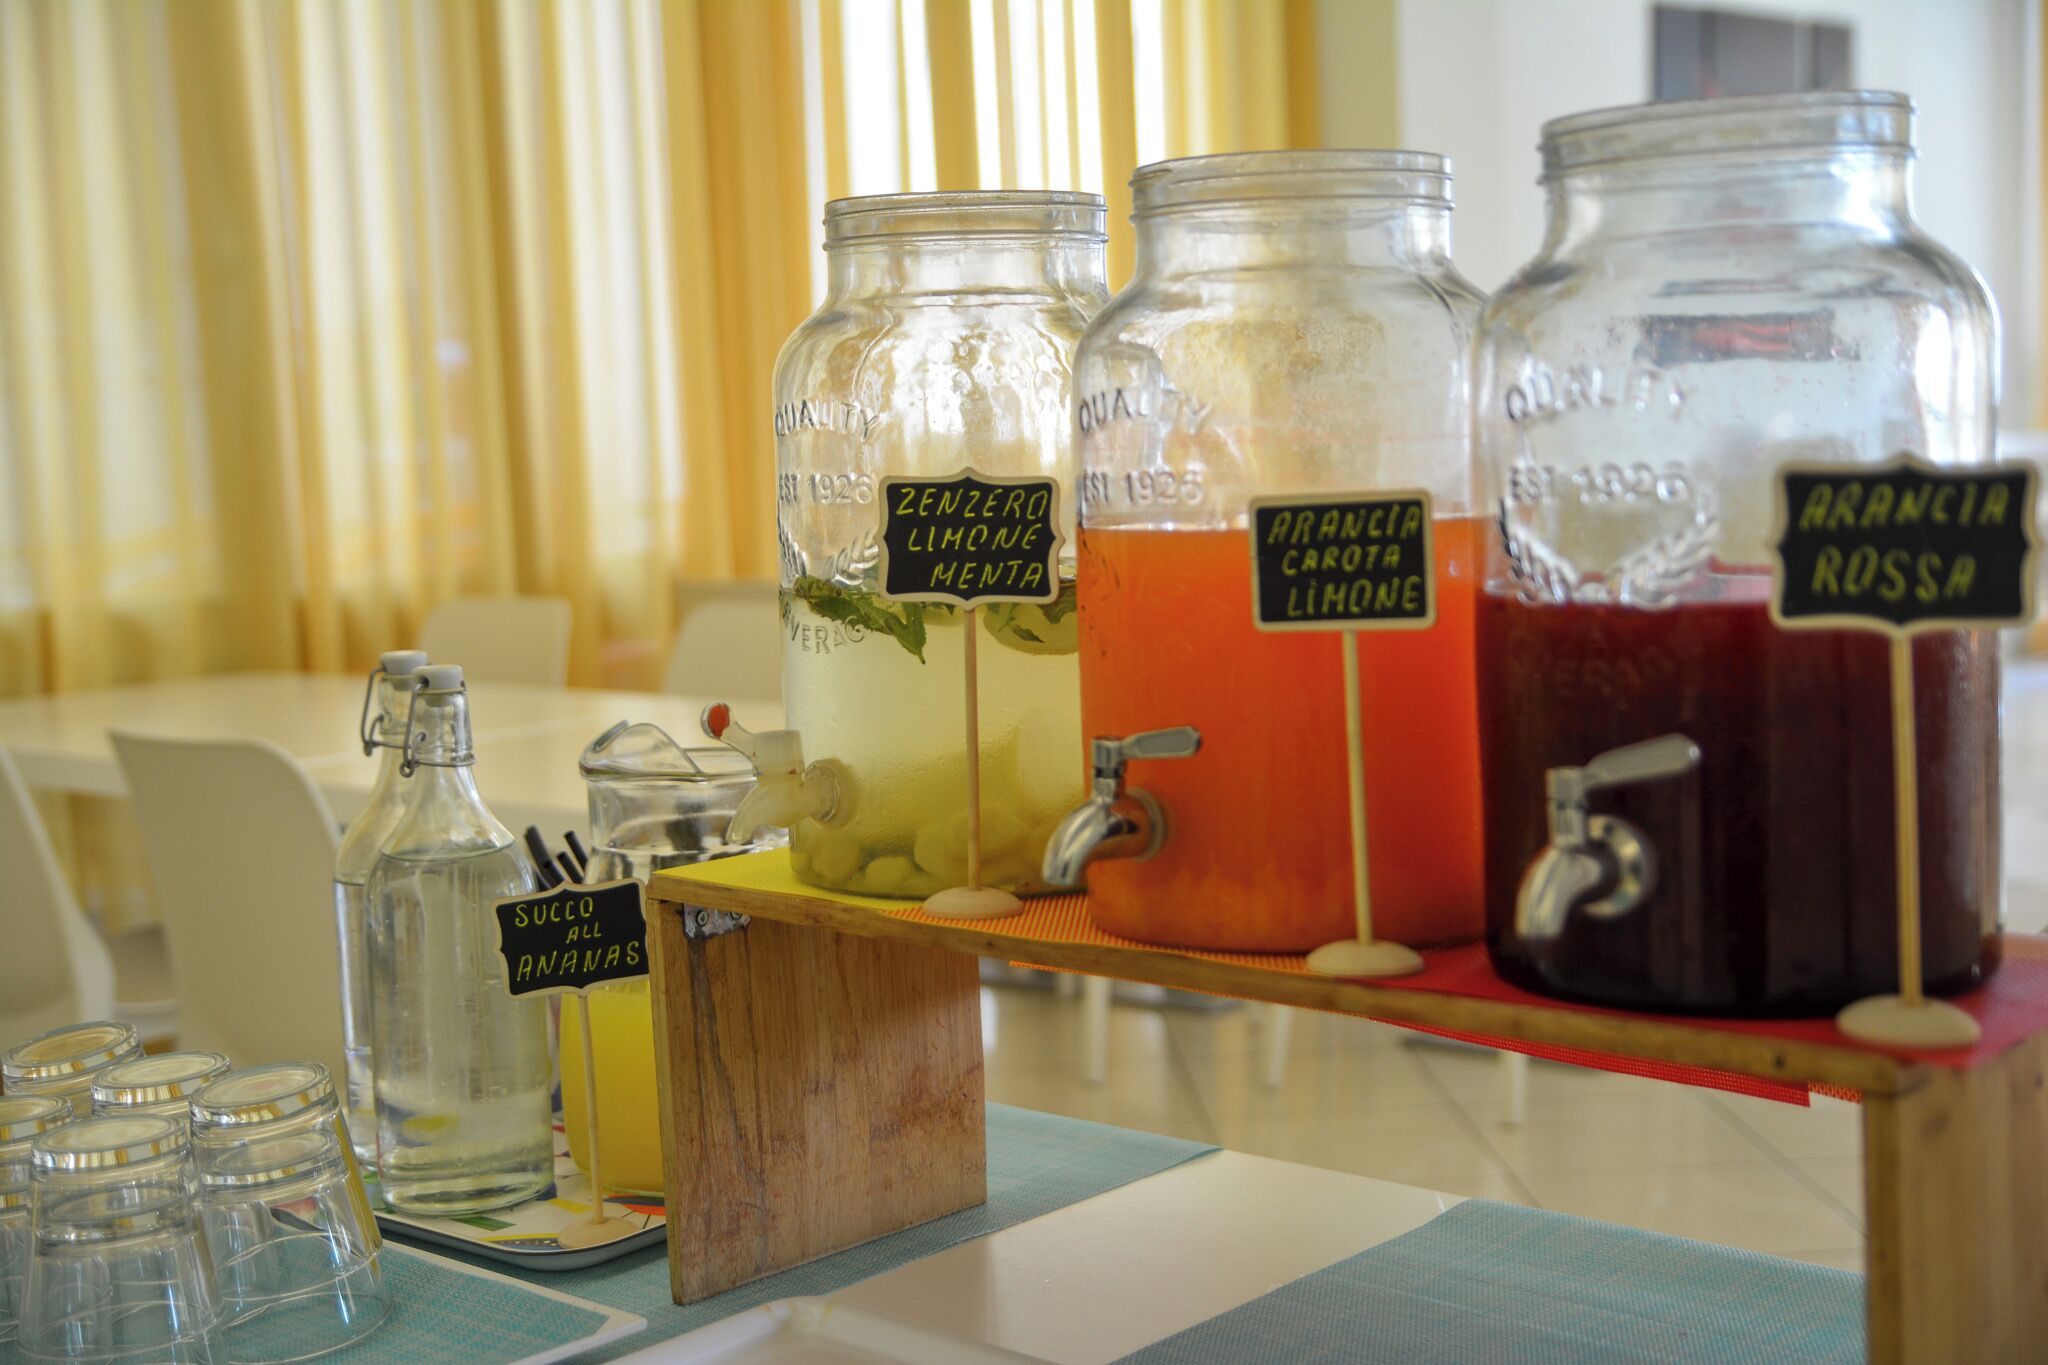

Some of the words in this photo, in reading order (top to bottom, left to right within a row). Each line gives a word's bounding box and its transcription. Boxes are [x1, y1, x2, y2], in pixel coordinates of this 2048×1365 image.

[774, 399, 880, 440] QUALITY
[1079, 387, 1212, 435] QUALTY
[896, 486, 1049, 520] ZENZERO
[1800, 480, 2010, 532] ARANCIA
[908, 523, 1043, 551] LIMONE
[1267, 503, 1423, 545] ARANCIA
[929, 560, 1043, 589] MENTA
[1281, 544, 1401, 577] CAROTA
[1811, 545, 1978, 604] ROSSA
[1287, 575, 1423, 618] LIMONE
[514, 896, 594, 927] SUCCO
[566, 921, 603, 944] ALL
[516, 940, 640, 982] ANANAS
